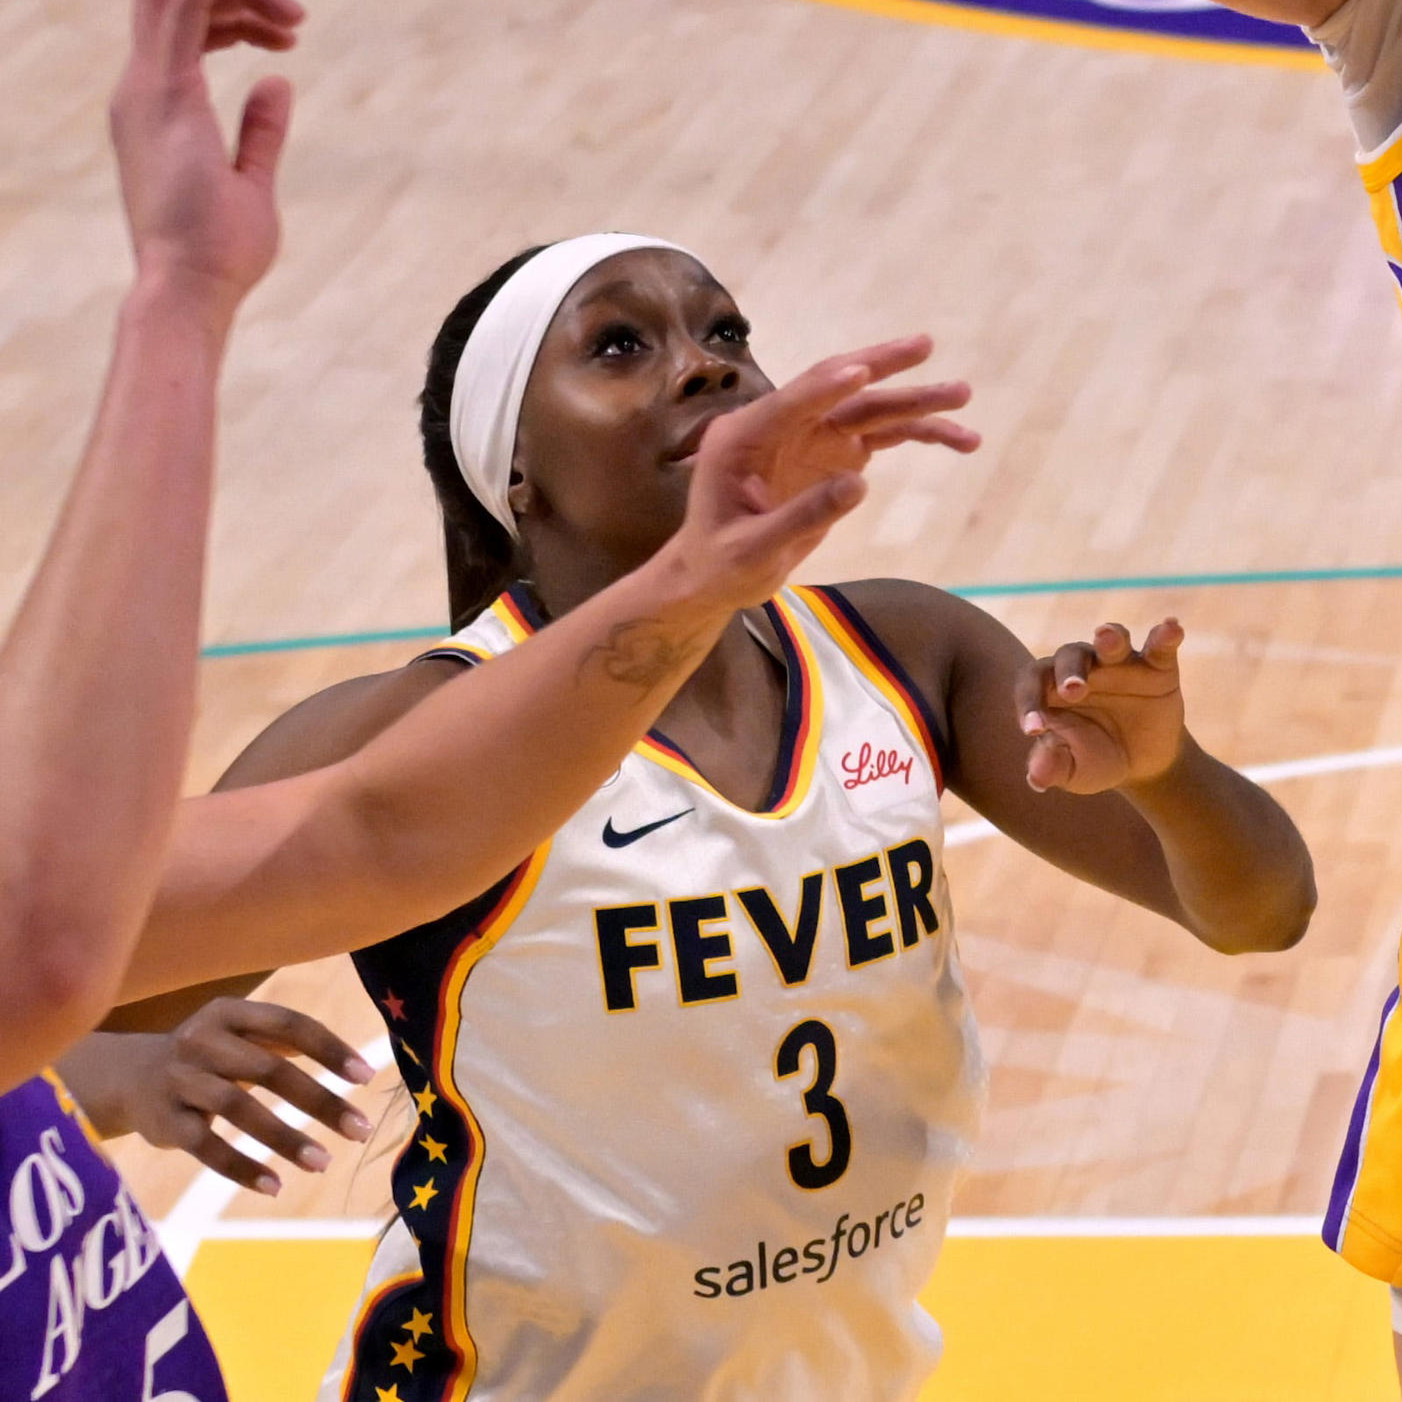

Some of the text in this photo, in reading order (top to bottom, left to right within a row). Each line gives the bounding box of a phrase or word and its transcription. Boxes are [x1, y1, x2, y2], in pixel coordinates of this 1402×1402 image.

[841, 741, 914, 791] Lilly
[592, 836, 940, 1014] FEVER
[773, 1016, 853, 1191] 3
[693, 1192, 925, 1299] salesforce
